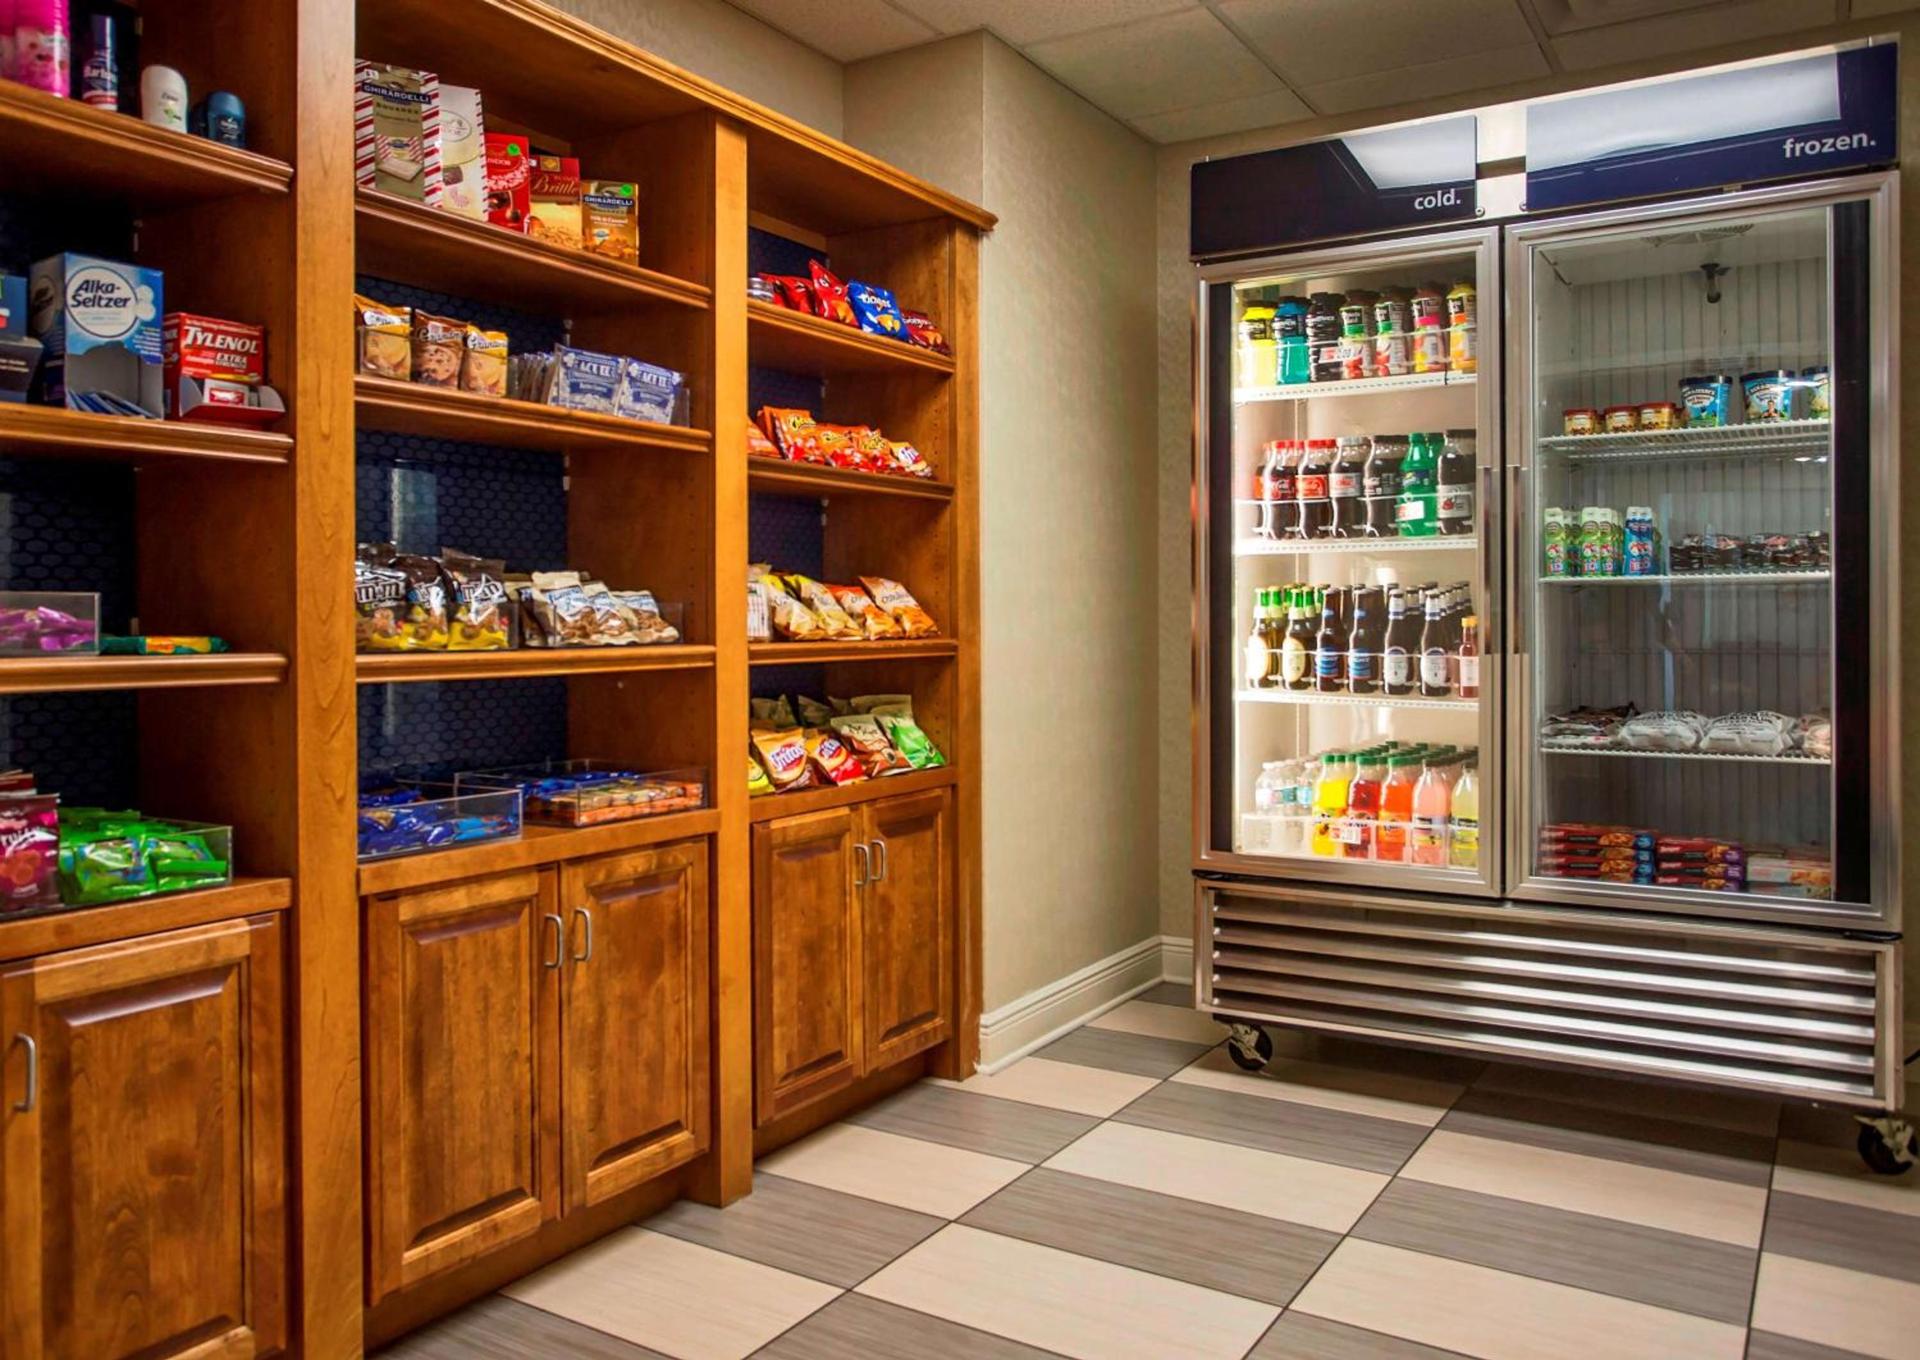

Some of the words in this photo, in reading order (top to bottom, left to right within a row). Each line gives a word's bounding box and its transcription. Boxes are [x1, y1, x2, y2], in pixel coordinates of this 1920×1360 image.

[364, 85, 429, 102] GHIRARDELLI
[1783, 132, 1876, 158] frozen.
[533, 175, 579, 194] Brittle
[584, 195, 633, 207] GHIRARDELLI
[1414, 188, 1461, 210] cold.
[75, 280, 121, 294] Alka-
[71, 294, 131, 308] Seltzer
[183, 326, 259, 354] TYLENOL
[216, 352, 247, 364] EXTRA
